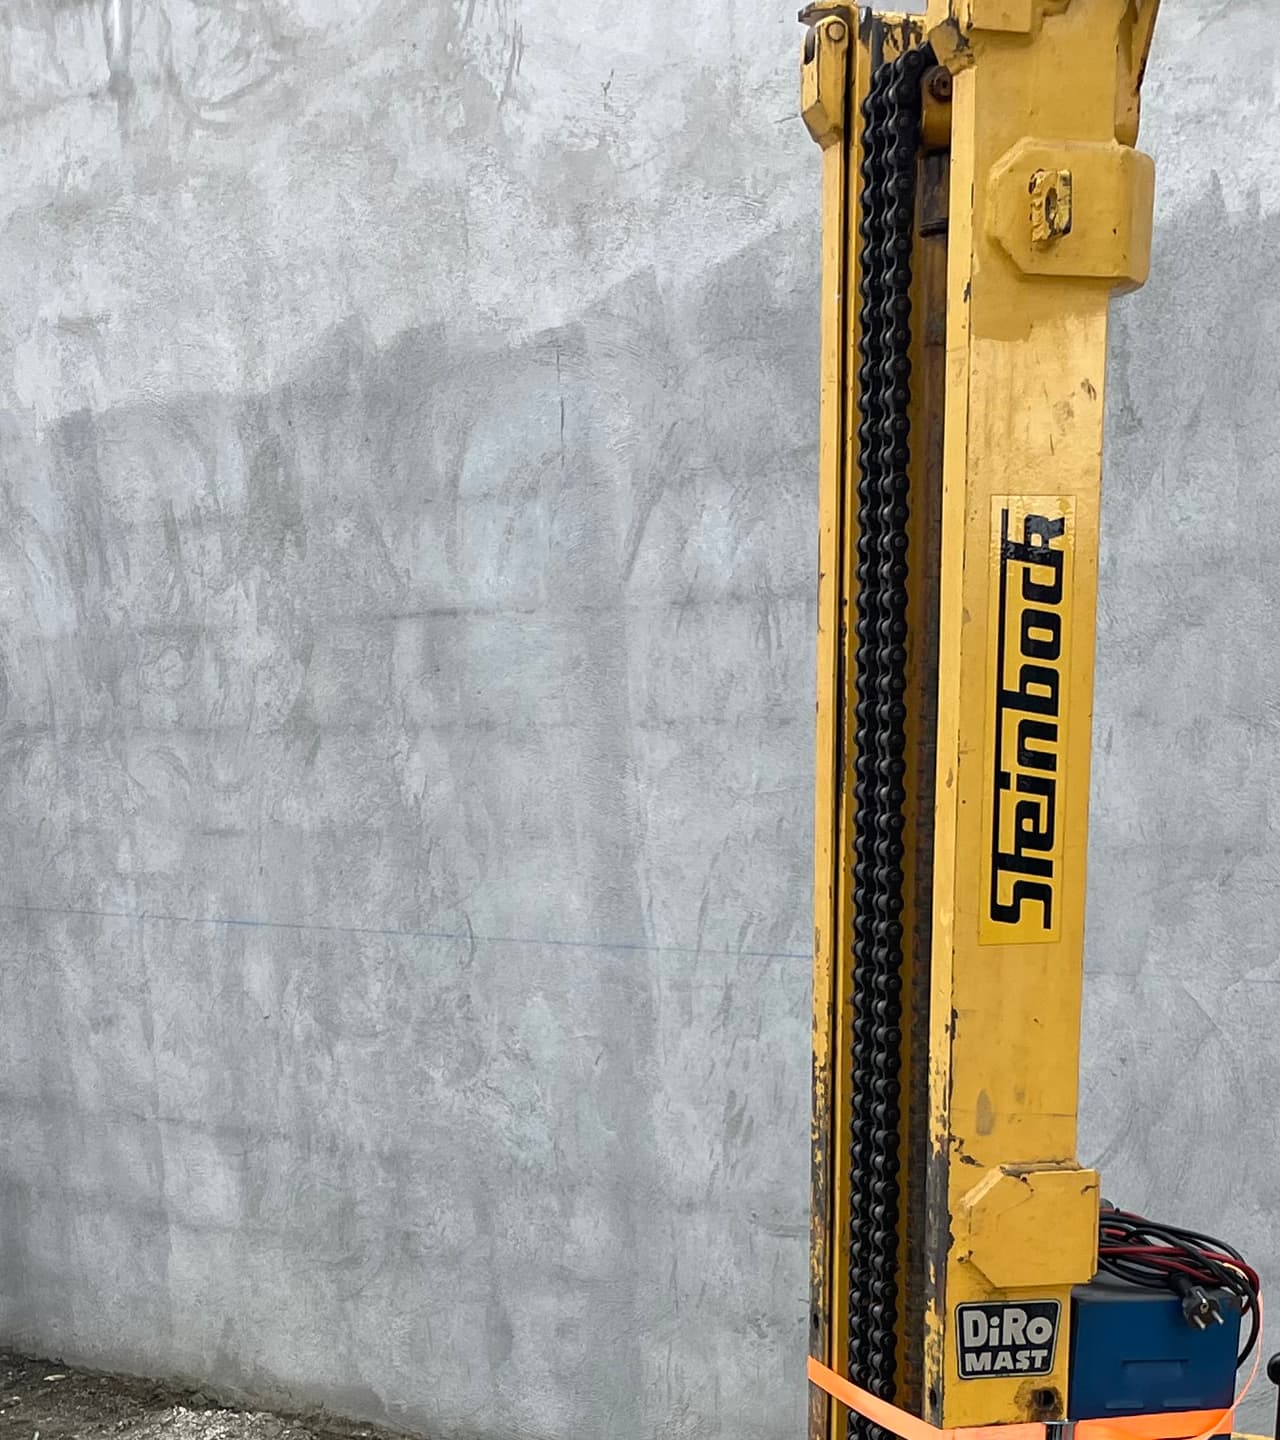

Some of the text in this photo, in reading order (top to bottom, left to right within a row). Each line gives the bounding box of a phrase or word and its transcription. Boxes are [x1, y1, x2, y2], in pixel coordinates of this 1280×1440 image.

[989, 508, 1065, 930] Steinbock
[963, 1308, 1052, 1347] DiRo
[965, 1349, 1048, 1372] MAST
